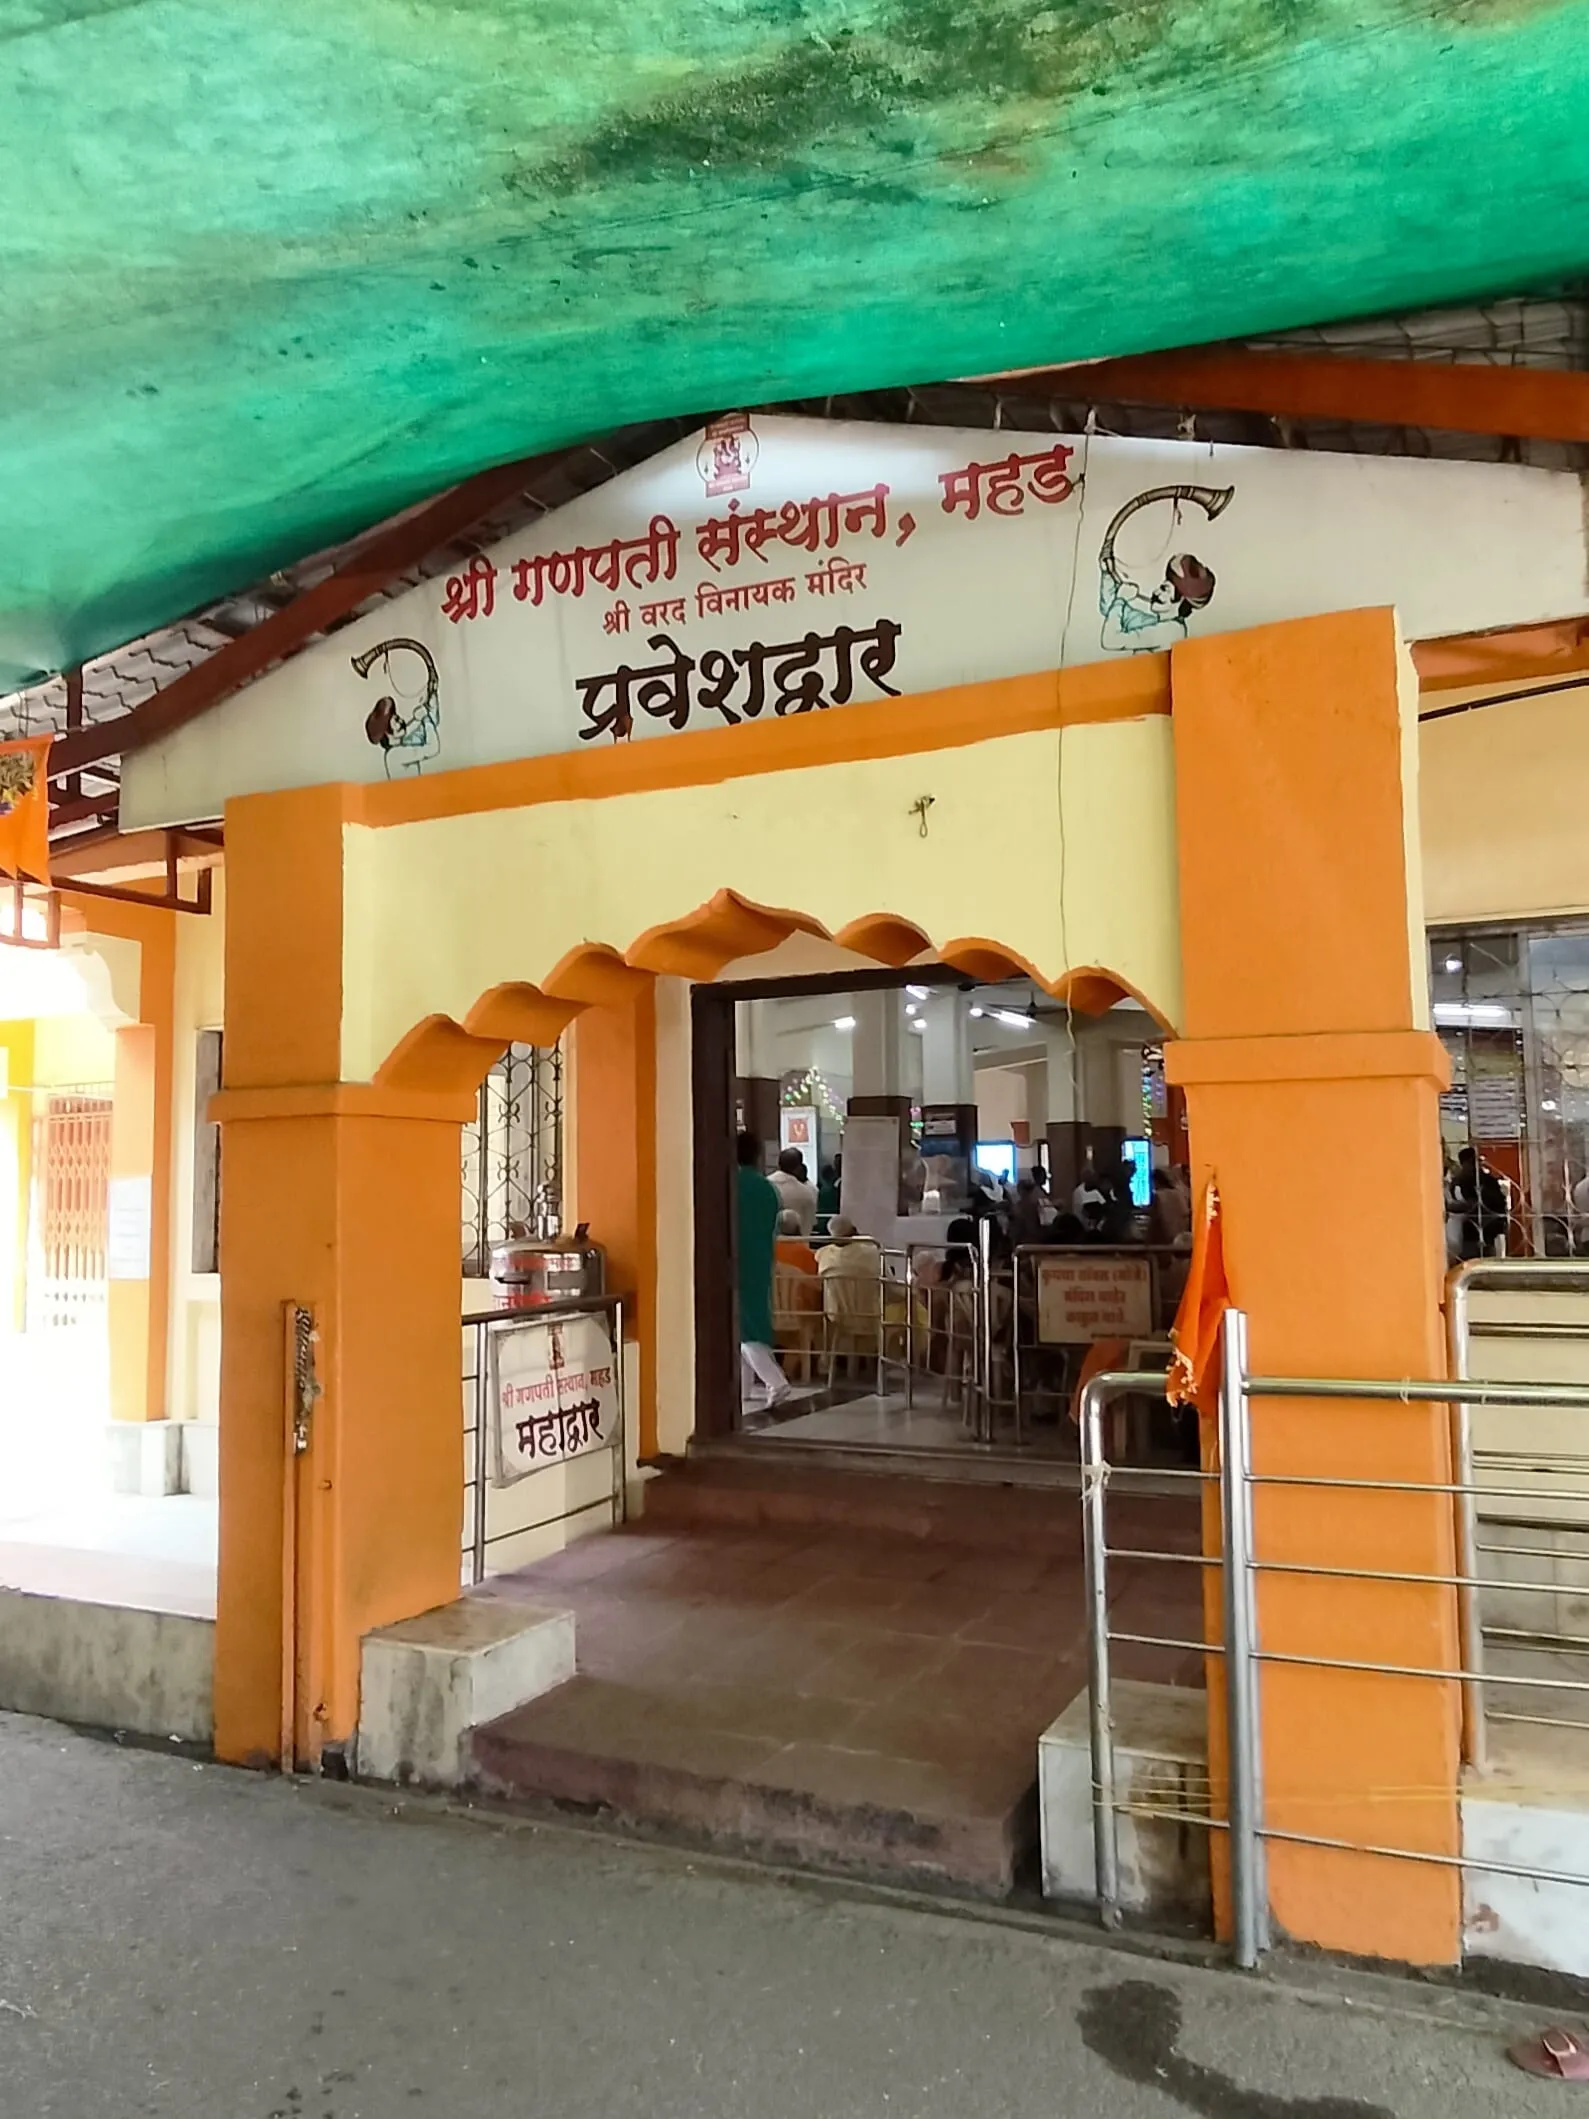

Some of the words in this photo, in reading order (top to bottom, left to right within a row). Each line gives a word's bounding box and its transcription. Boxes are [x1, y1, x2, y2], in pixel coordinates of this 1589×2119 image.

[441, 556, 496, 623] श्री
[511, 514, 680, 607] गणपती
[695, 482, 917, 570] संस्थान,
[938, 444, 1074, 520] महड
[602, 601, 631, 634] श्री
[639, 595, 686, 628] वरद
[695, 579, 796, 618] विनायक
[806, 558, 868, 597] मंदिर
[575, 618, 902, 741] प्रवेशद्वार
[515, 1397, 604, 1459] महाद्वार
